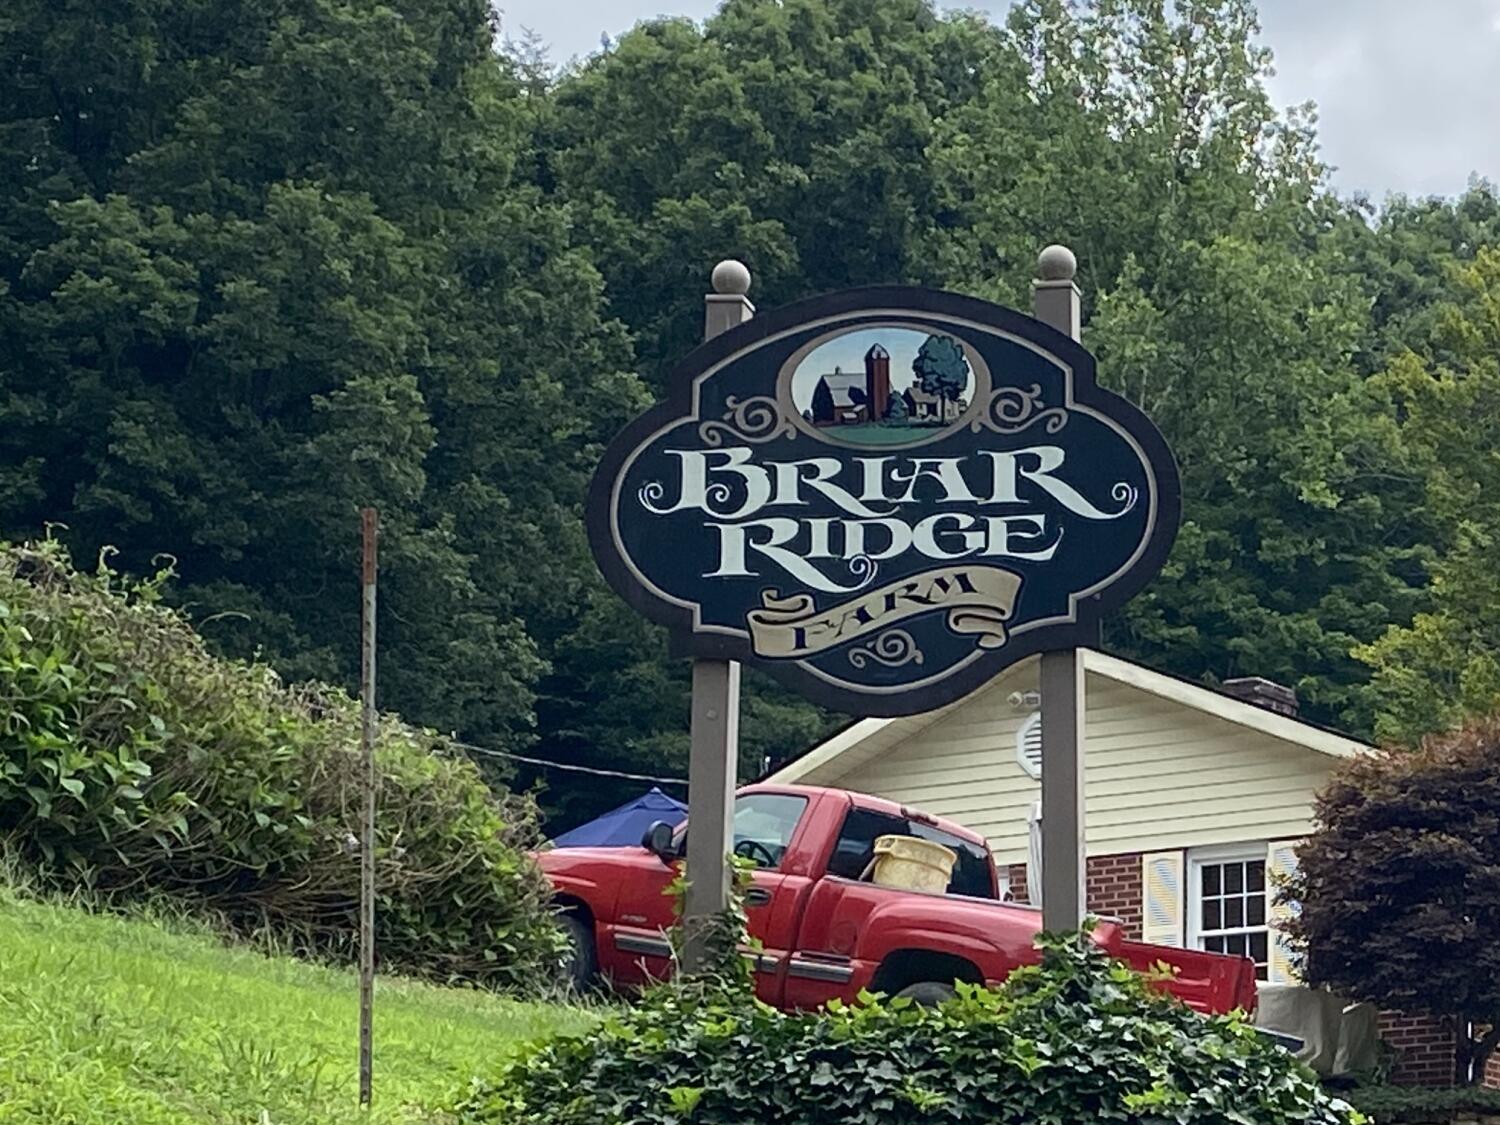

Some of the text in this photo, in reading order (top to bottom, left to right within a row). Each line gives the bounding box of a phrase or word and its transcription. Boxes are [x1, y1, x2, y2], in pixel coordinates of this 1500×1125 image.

[638, 444, 1138, 518] BRIAR
[701, 513, 1064, 594] RIDGE
[791, 572, 979, 650] FARM
